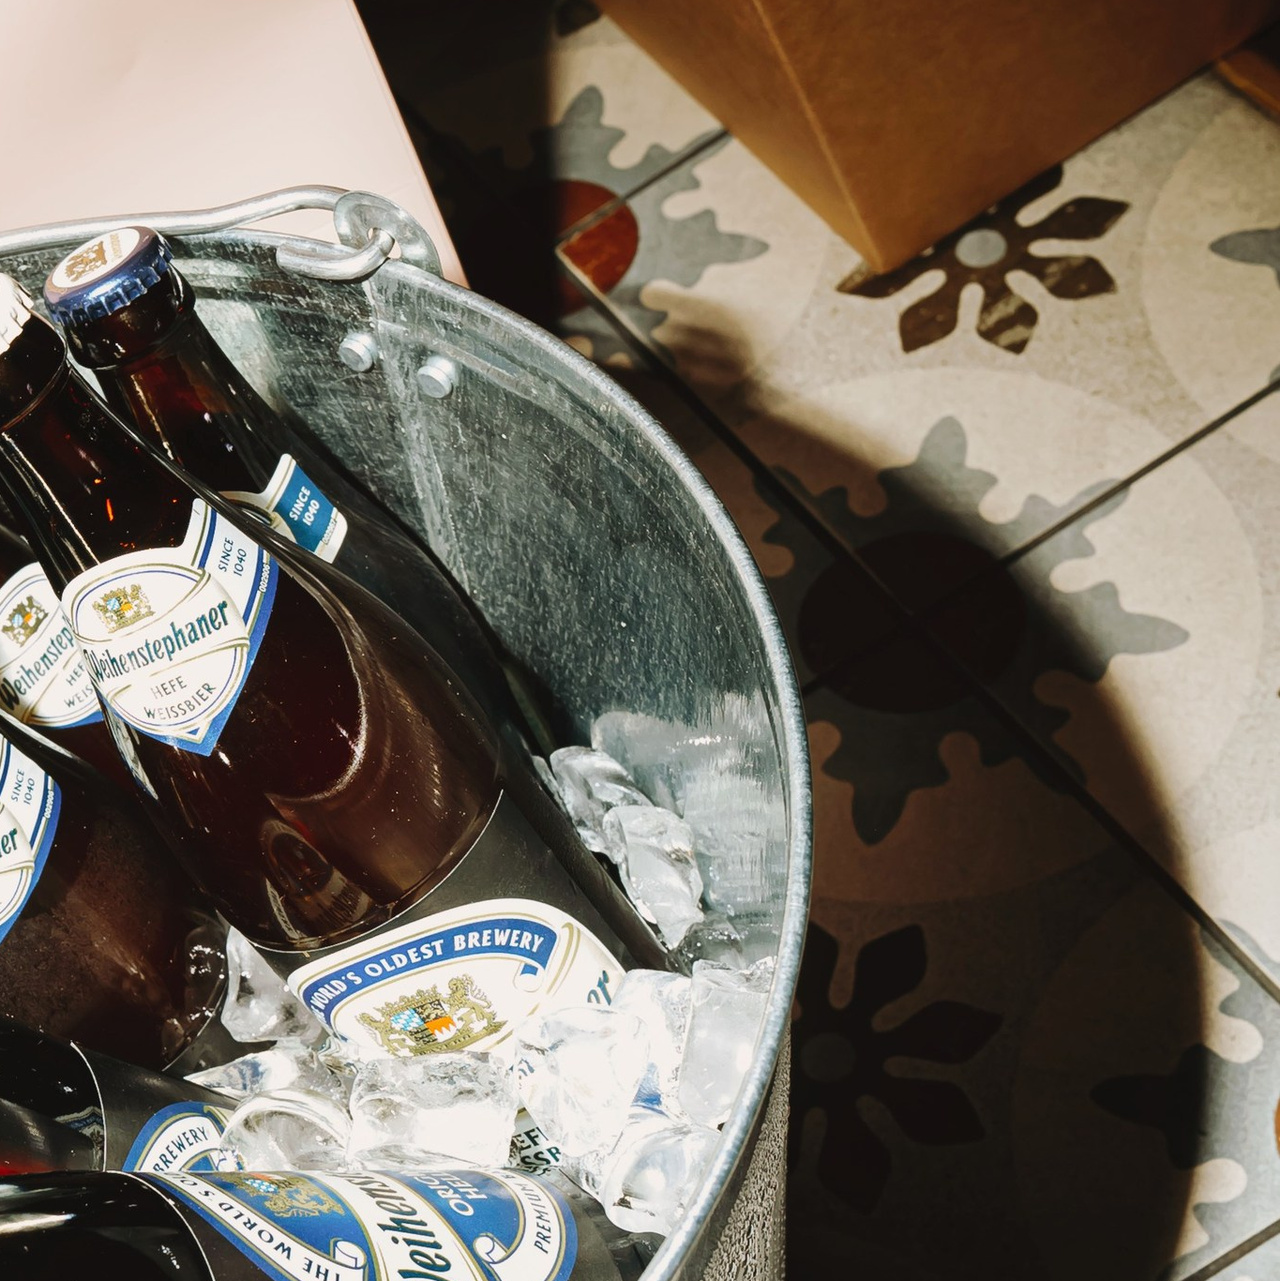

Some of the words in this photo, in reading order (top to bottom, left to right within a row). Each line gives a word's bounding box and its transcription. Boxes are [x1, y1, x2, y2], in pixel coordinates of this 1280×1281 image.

[289, 486, 311, 520] SINCE
[302, 499, 320, 526] 1040
[218, 537, 234, 572] SINCE
[233, 548, 247, 577] 1040
[83, 599, 230, 683] Weihenstephaner
[65, 661, 85, 686] HEF
[150, 675, 187, 699] HEFE
[143, 681, 217, 721] WEISSBIER
[10, 768, 25, 803] SINCE
[23, 777, 35, 806] 1040
[364, 939, 444, 977] OLDEST
[453, 928, 545, 953] BREWERY
[516, 1183, 552, 1254] PREMIUM
